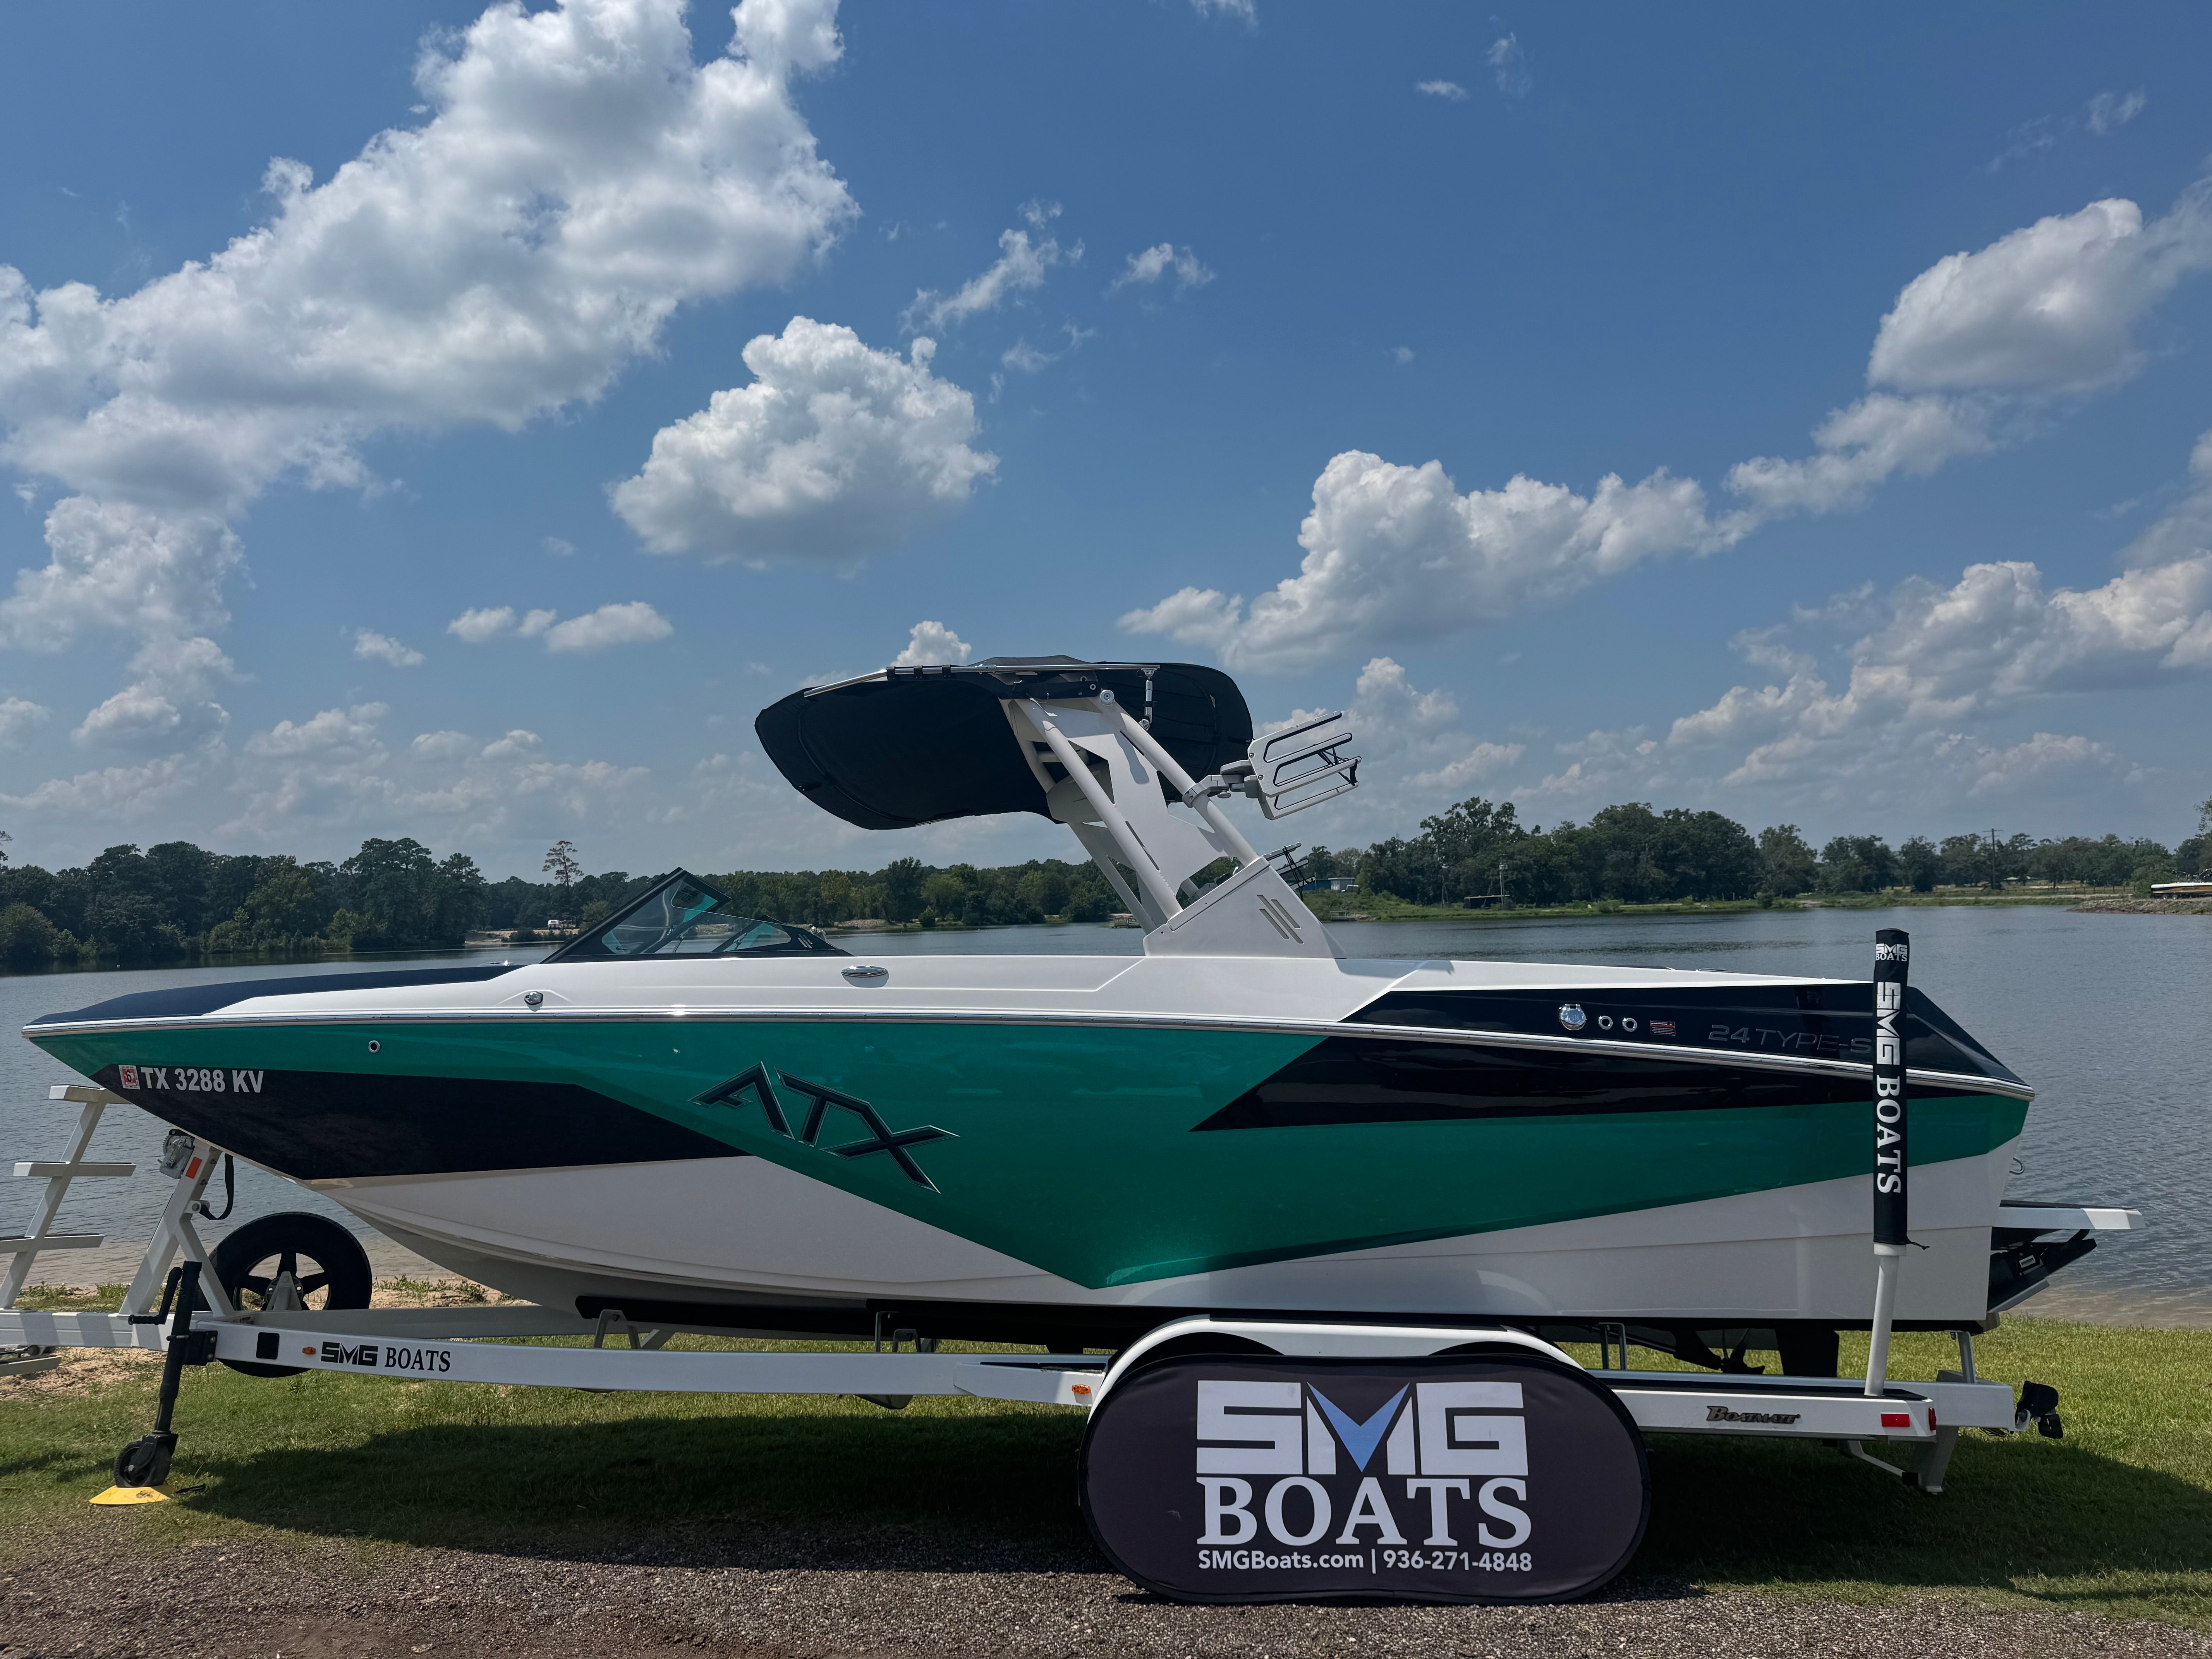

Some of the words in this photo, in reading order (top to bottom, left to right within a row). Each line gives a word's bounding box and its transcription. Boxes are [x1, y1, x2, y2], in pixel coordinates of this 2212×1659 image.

[1875, 953, 1908, 962] BOATS
[1876, 943, 1908, 955] SMG
[1877, 982, 1901, 1065] SMG
[141, 1067, 170, 1089] TX
[174, 1068, 225, 1092] 3288
[232, 1070, 264, 1093] KV
[687, 1061, 960, 1194] ATX
[1877, 1075, 1901, 1193] BOATS
[321, 1341, 378, 1367] SMG
[384, 1347, 450, 1372] BOATS
[1196, 1380, 1528, 1476] SMG
[1196, 1476, 1532, 1549] BOATS
[1198, 1550, 1364, 1570] SMGBoats.com
[1383, 1550, 1532, 1571] 936-271-4848
